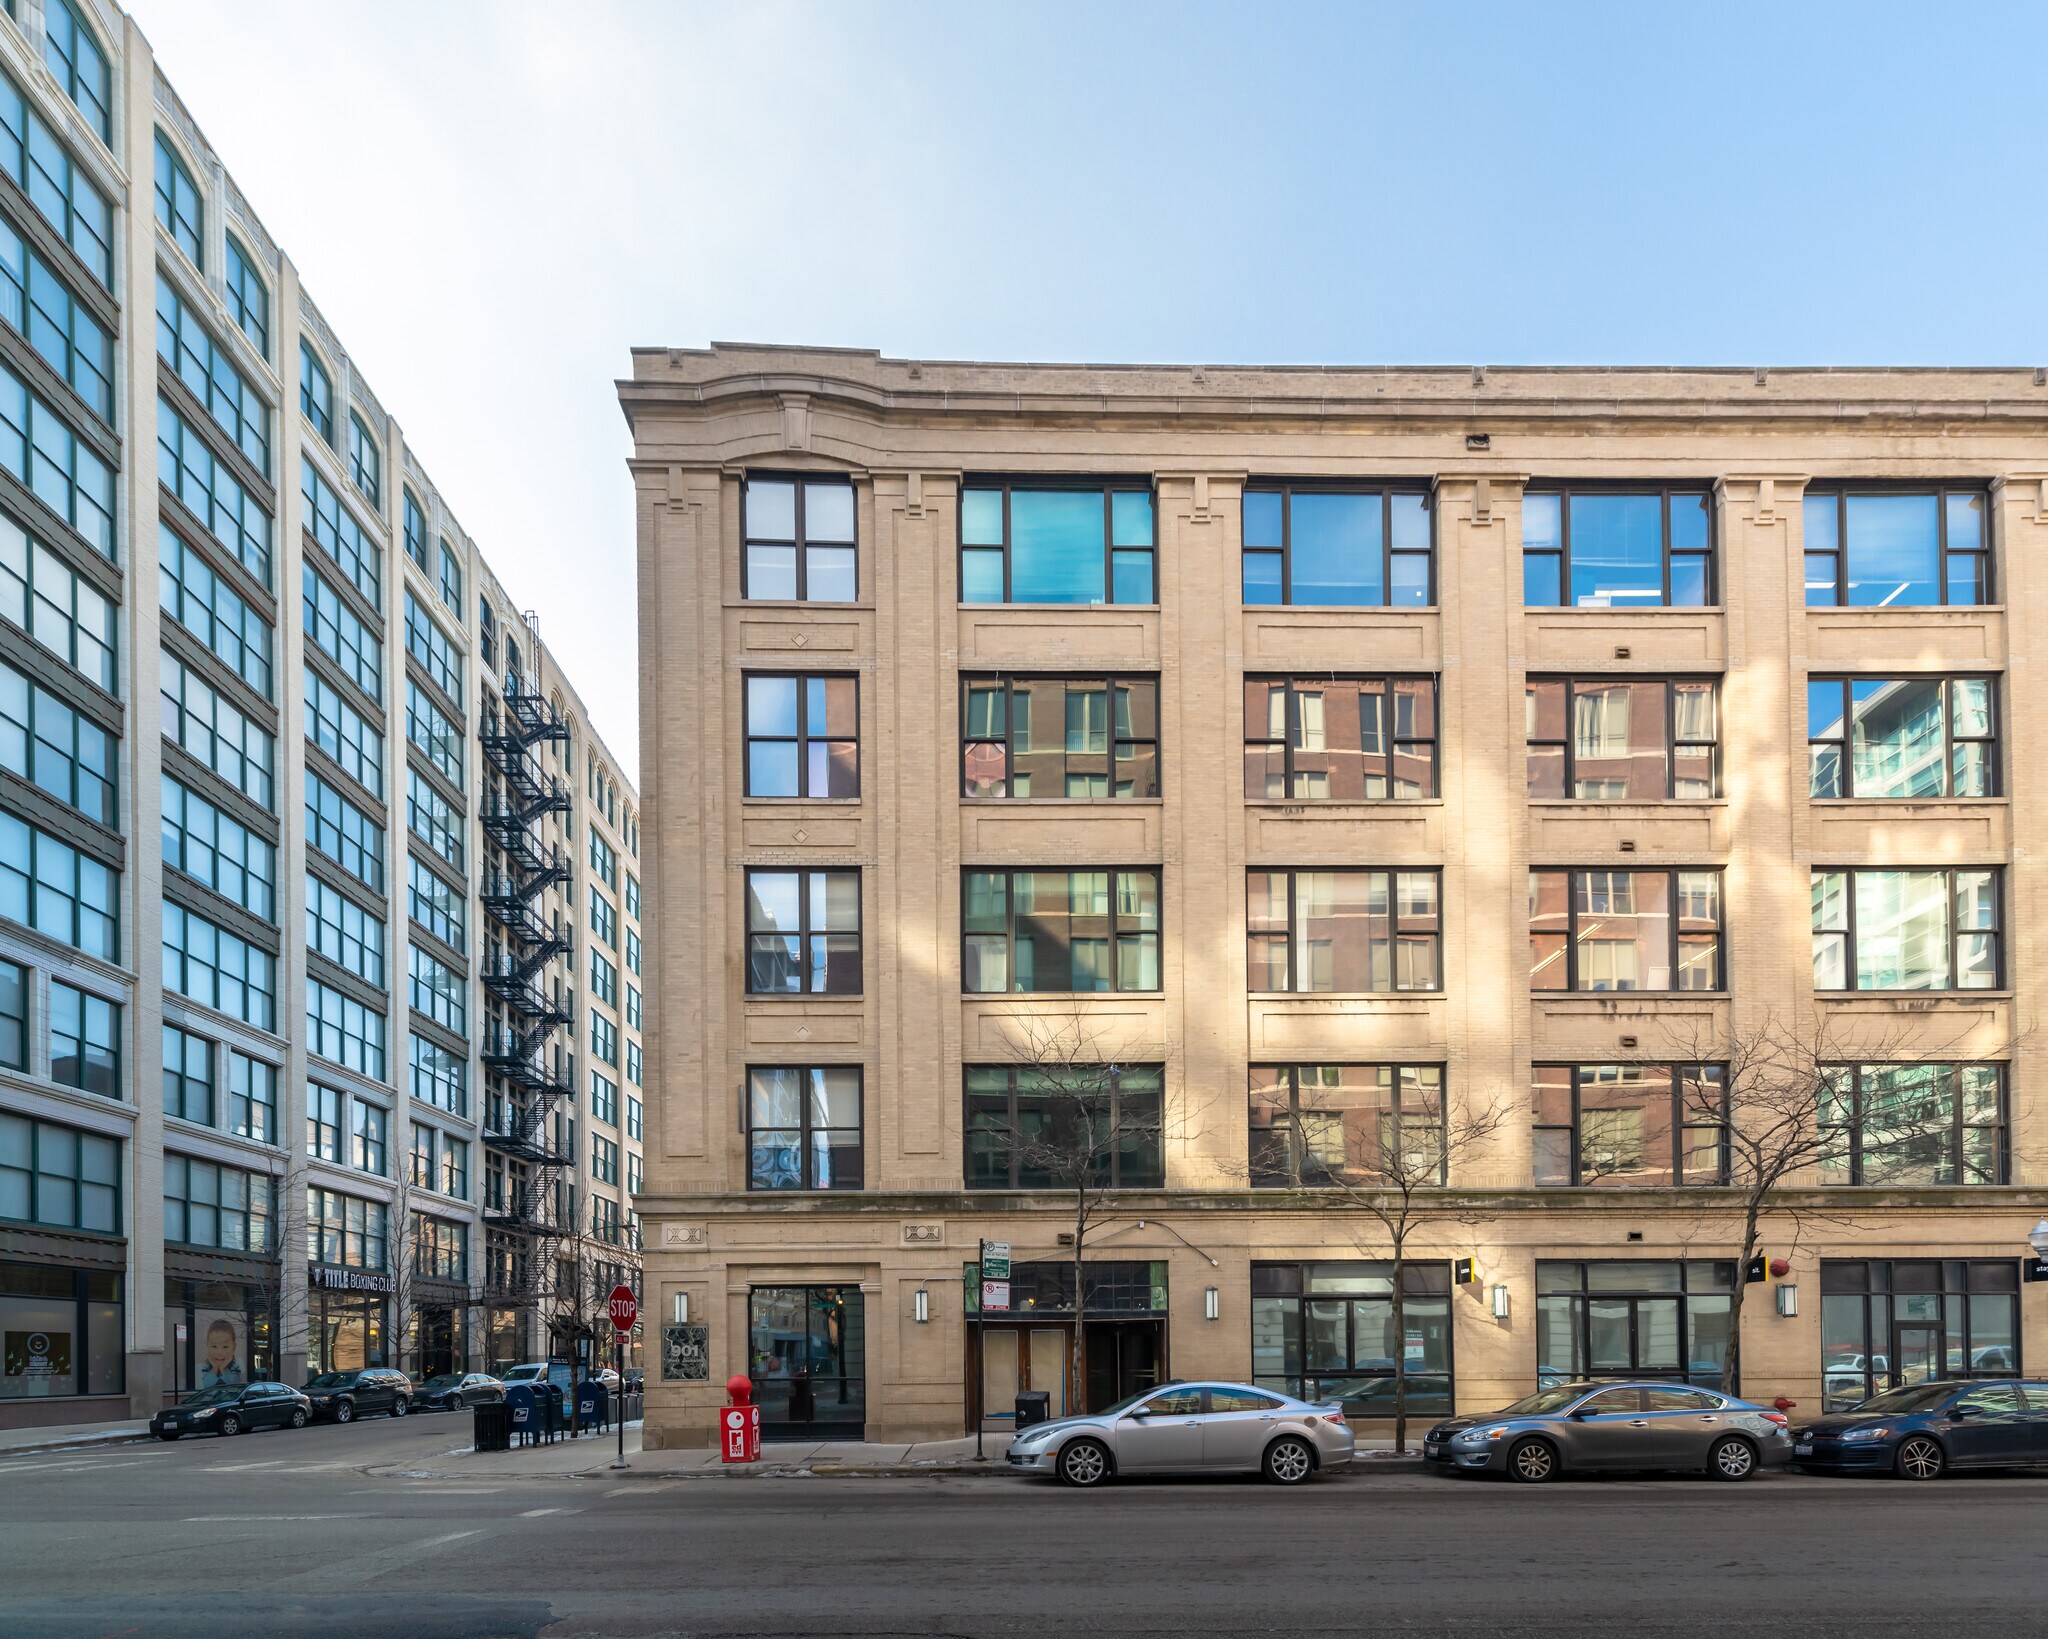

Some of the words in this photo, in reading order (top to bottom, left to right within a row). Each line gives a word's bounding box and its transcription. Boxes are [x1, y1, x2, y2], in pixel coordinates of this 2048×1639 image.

[324, 1268, 348, 1289] TITLE
[350, 1273, 377, 1291] BOXING
[378, 1277, 397, 1293] CLUB
[610, 1299, 635, 1317] STOP
[671, 1344, 699, 1357] 901
